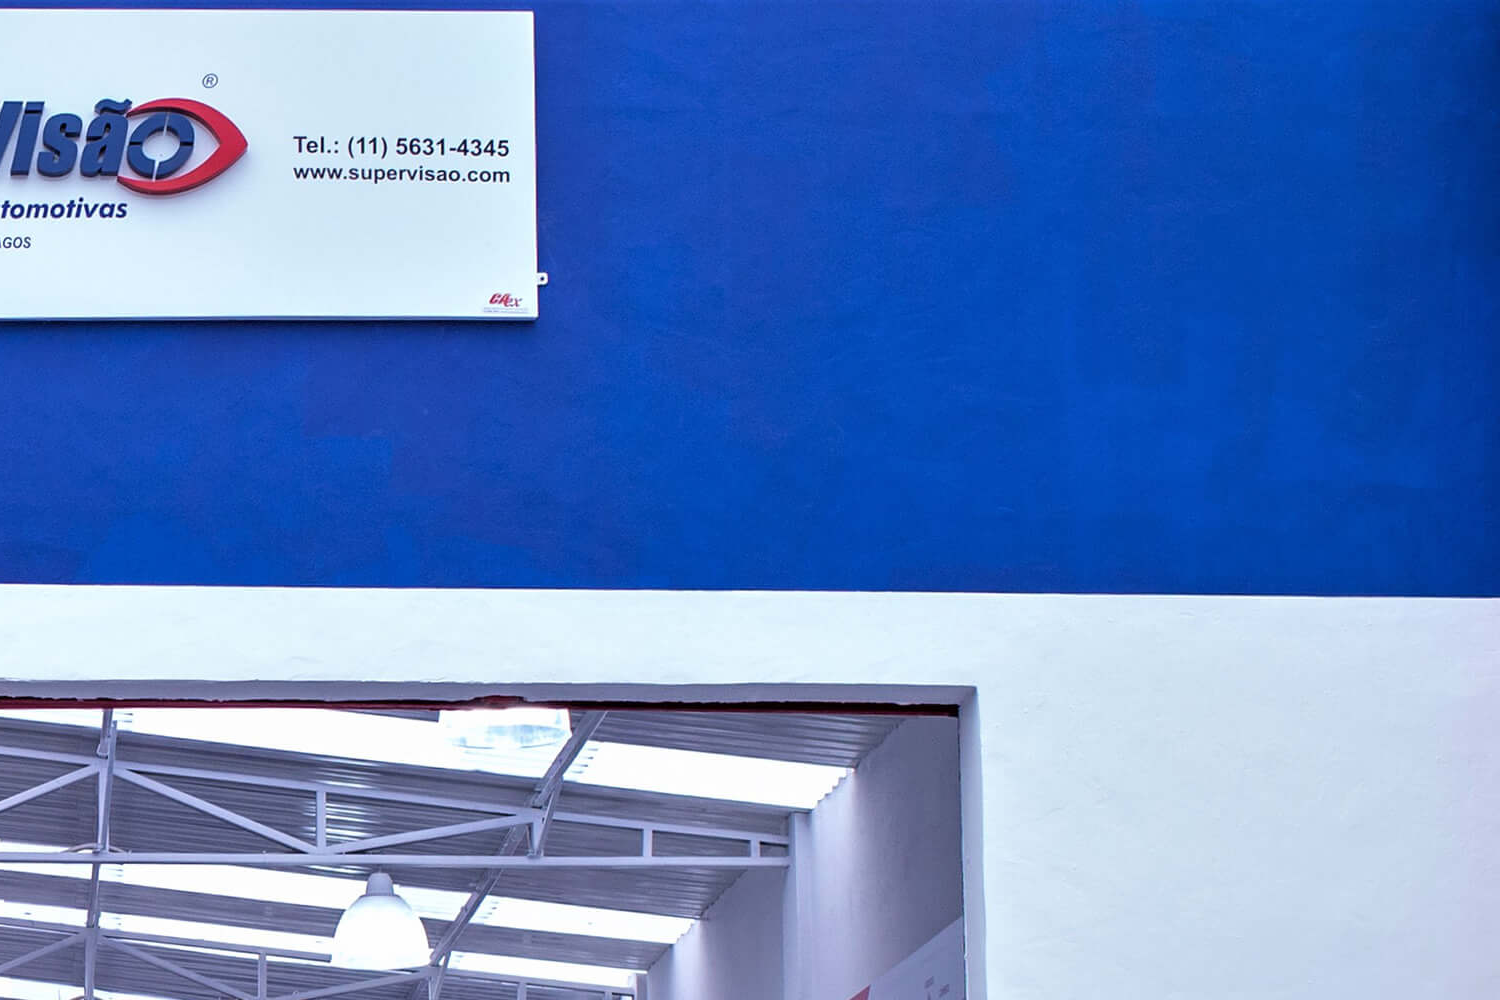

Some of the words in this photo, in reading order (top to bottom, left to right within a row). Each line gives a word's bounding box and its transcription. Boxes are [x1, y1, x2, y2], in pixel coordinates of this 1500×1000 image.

[293, 135, 340, 154] Tel.:
[347, 136, 388, 159] (11)
[395, 137, 511, 157] 5631-4345
[293, 165, 511, 184] www.supervisao.com
